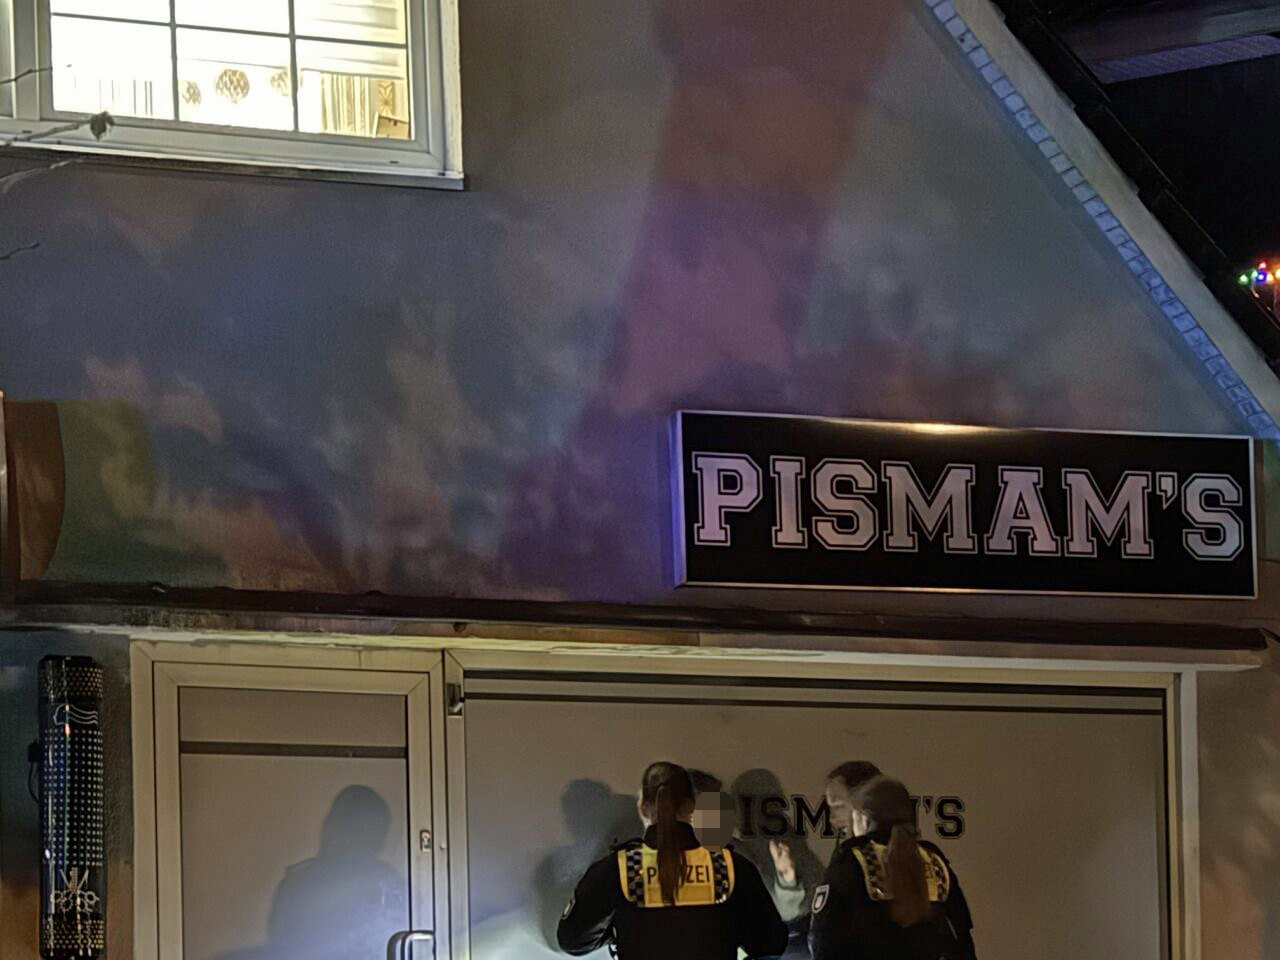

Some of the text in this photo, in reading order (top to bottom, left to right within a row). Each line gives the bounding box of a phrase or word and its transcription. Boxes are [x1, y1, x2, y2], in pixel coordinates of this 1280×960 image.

[691, 450, 1245, 561] PISMAM'S
[739, 795, 967, 840] ISM'S
[646, 864, 711, 885] PZEI
